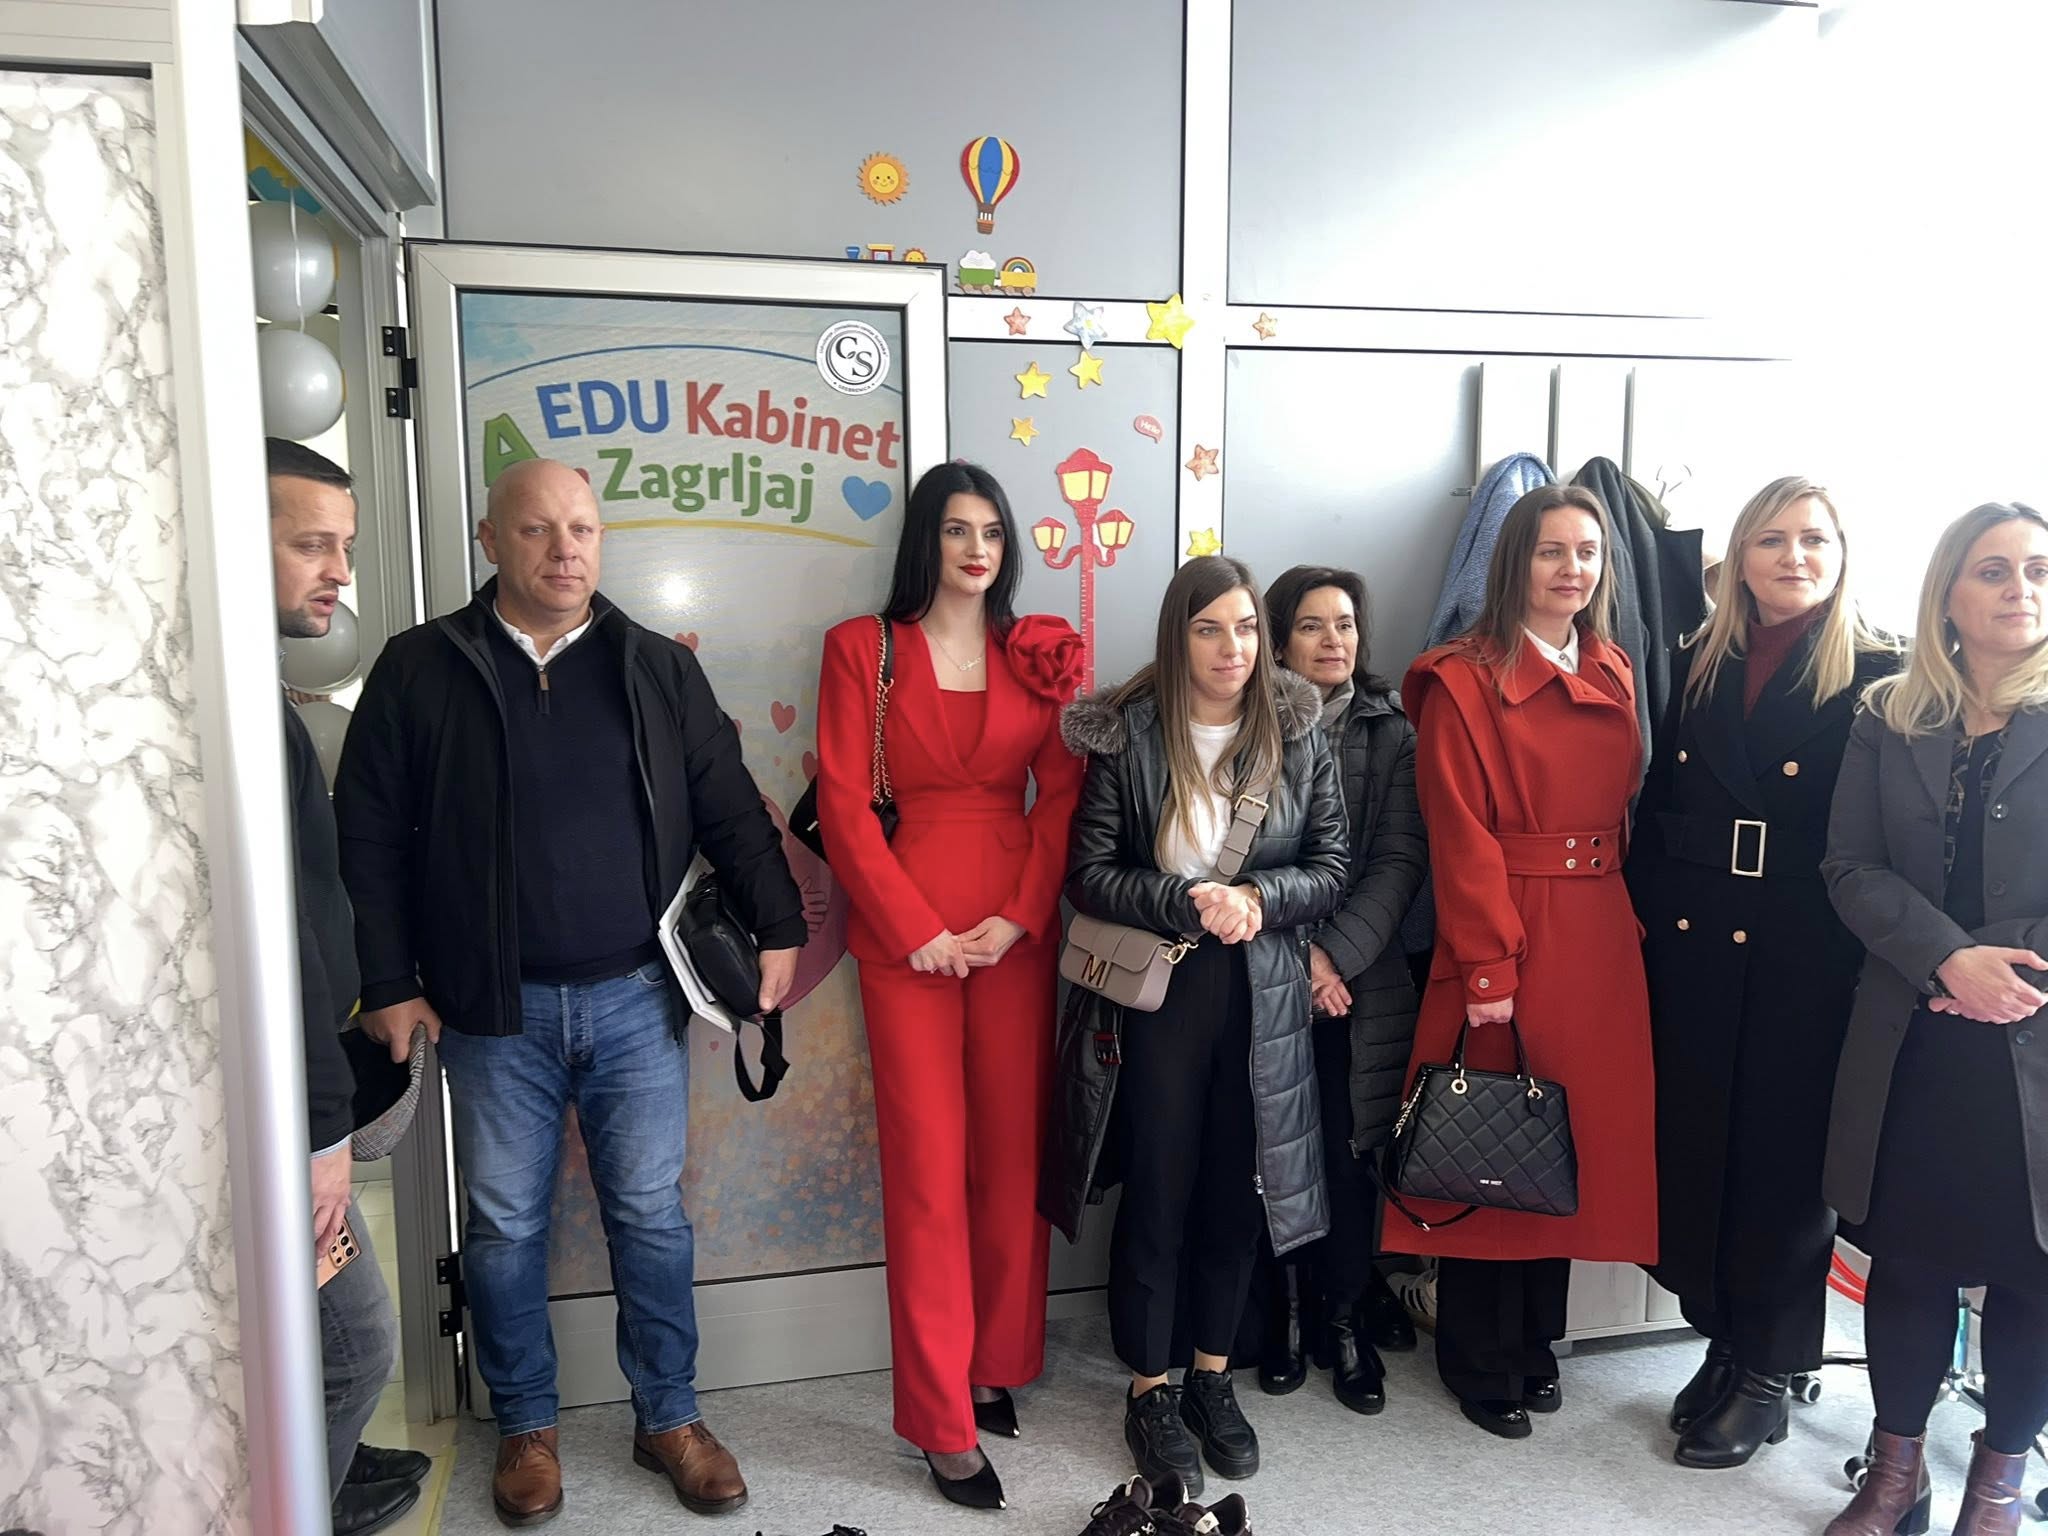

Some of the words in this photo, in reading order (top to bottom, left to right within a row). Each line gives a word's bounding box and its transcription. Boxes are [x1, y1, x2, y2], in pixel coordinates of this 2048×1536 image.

[536, 379, 669, 438] EDU
[686, 381, 901, 469] Kabinet
[597, 447, 814, 523] Zagrljaj
[1081, 954, 1111, 989] M
